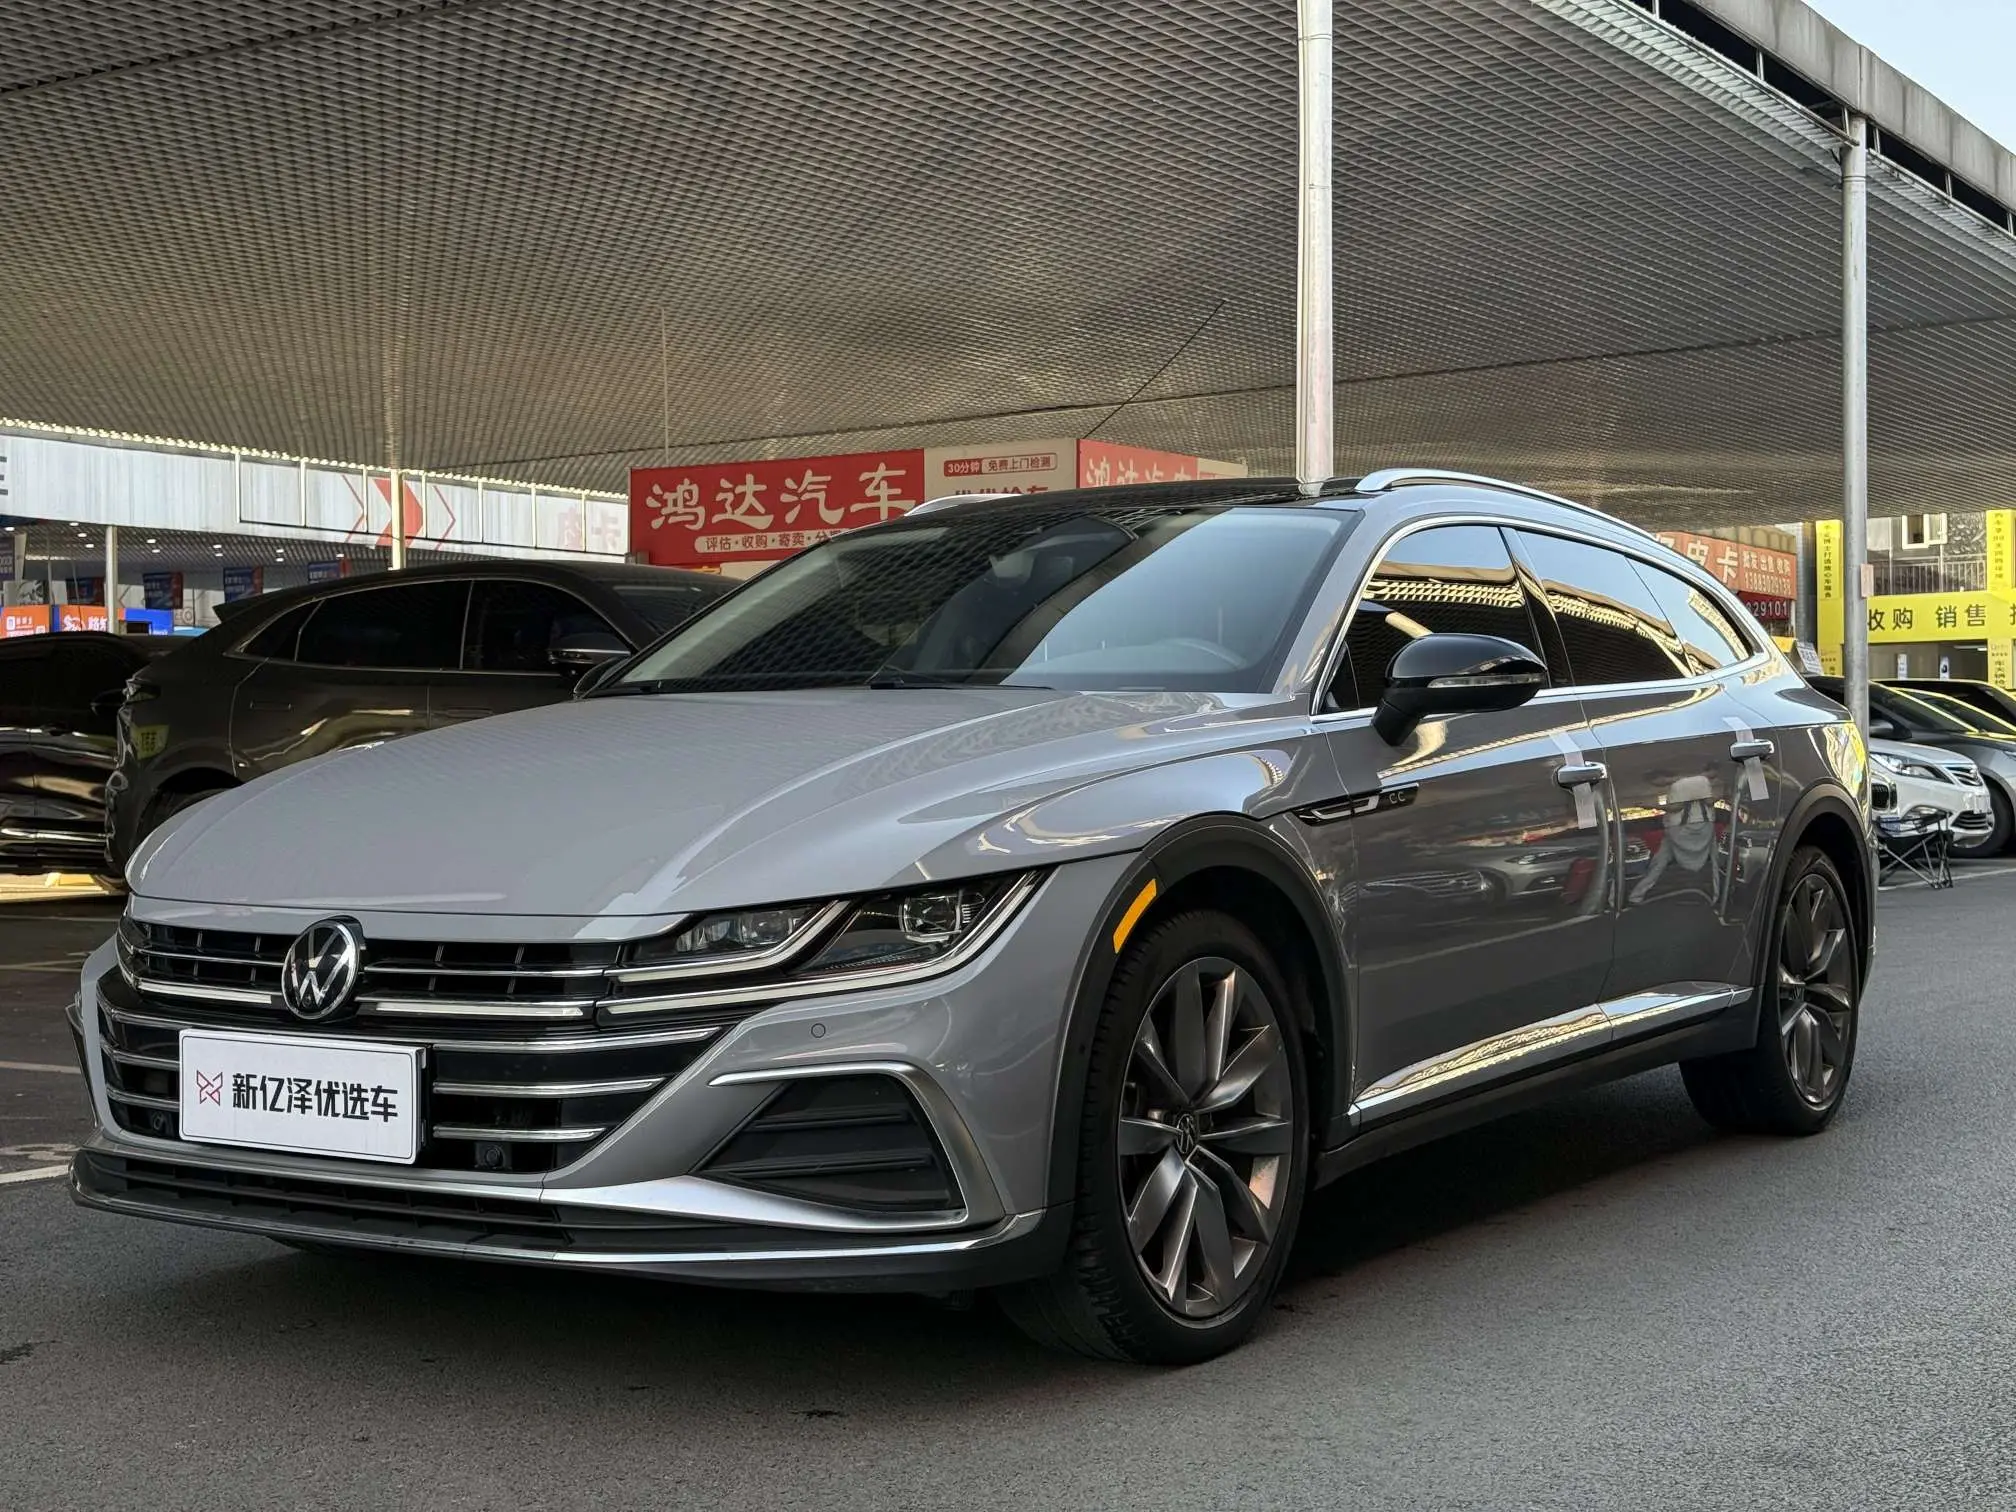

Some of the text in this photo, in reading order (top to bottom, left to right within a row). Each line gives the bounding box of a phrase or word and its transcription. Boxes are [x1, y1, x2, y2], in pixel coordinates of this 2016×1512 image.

[947, 455, 1051, 474] 30分钟 免费上门检测
[646, 461, 916, 530] 鸿达汽车
[1867, 606, 1914, 631] 收购
[1935, 603, 1987, 629] 销售
[232, 1073, 398, 1122] 新亿泽优选车
